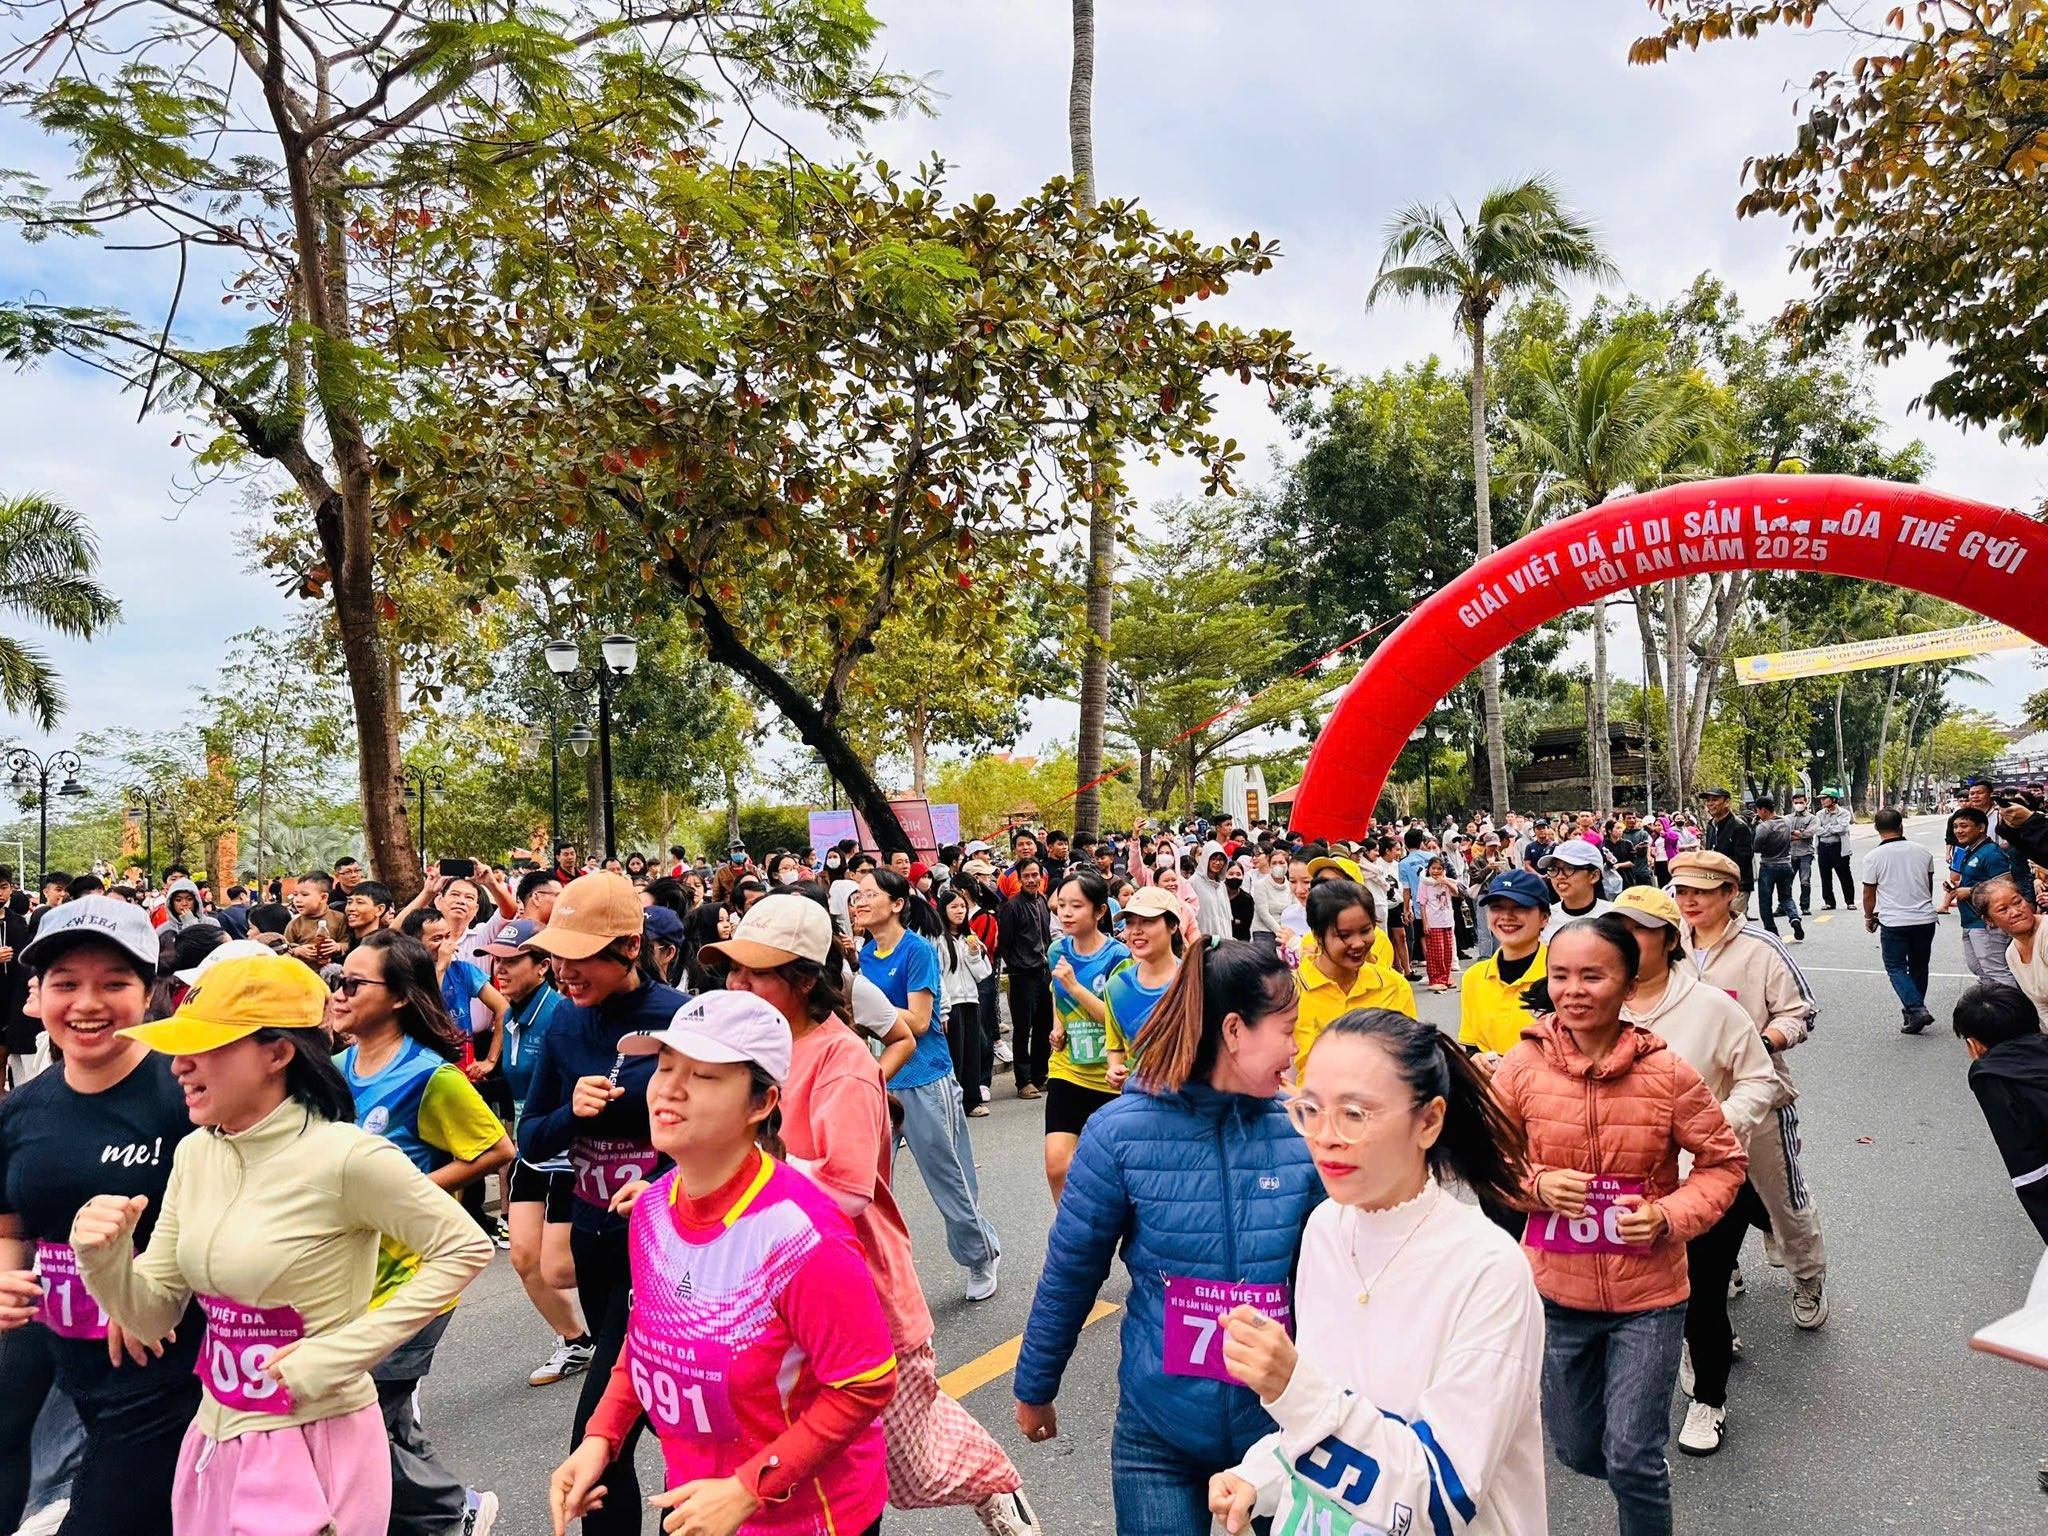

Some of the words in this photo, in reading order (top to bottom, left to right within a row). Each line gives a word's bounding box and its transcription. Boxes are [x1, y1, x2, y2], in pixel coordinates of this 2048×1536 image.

[1458, 583, 1510, 629] GIẢI
[1506, 551, 1560, 595] VIỆT
[1568, 530, 1606, 568] DÃ
[1643, 517, 1672, 546] DI
[1683, 500, 1741, 538] SẢN
[1898, 515, 1962, 552] THẾ
[1634, 547, 1675, 574] AN
[1679, 535, 1745, 565] NĂM
[1755, 536, 1828, 562] 2025
[88, 914, 118, 931] ERA
[101, 1136, 162, 1168] me!
[1195, 1285, 1226, 1301] GIẢI
[1229, 1289, 1261, 1304] VIỆT
[211, 1305, 237, 1324] VIỆT
[630, 1357, 713, 1434] 691
